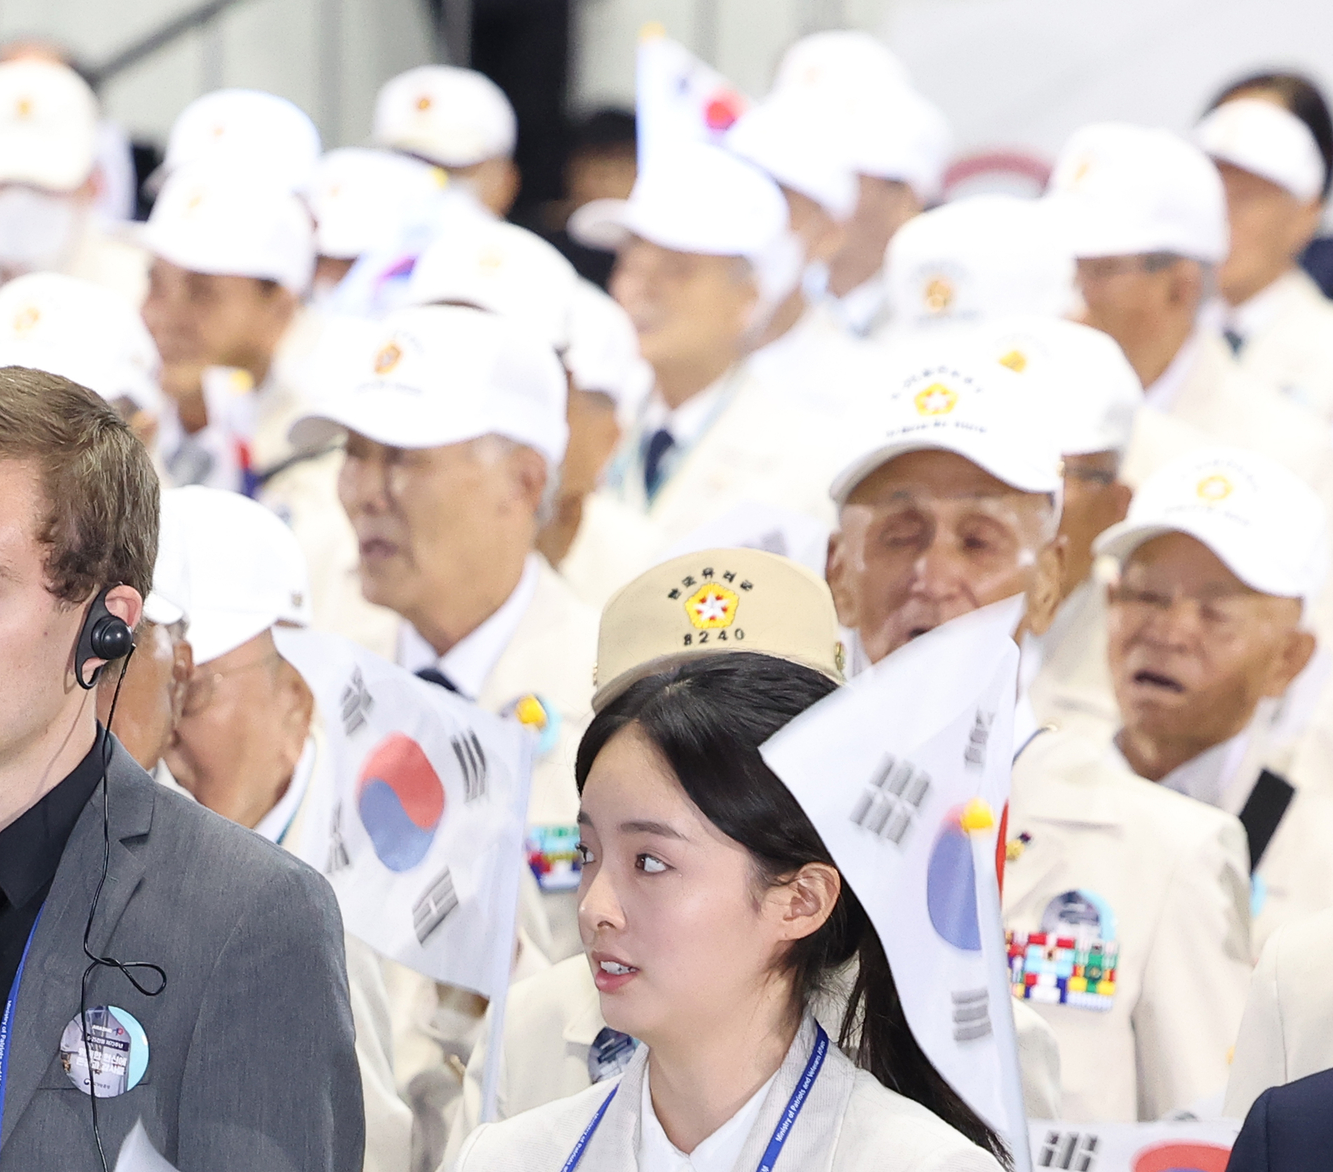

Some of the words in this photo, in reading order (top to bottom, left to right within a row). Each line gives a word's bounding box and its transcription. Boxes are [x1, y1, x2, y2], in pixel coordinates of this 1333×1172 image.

[683, 628, 745, 647] 8240
[775, 1117, 792, 1142] Ministry
[790, 1088, 806, 1111] Patriots
[801, 1077, 811, 1089] and
[807, 1054, 821, 1078] Veterans
